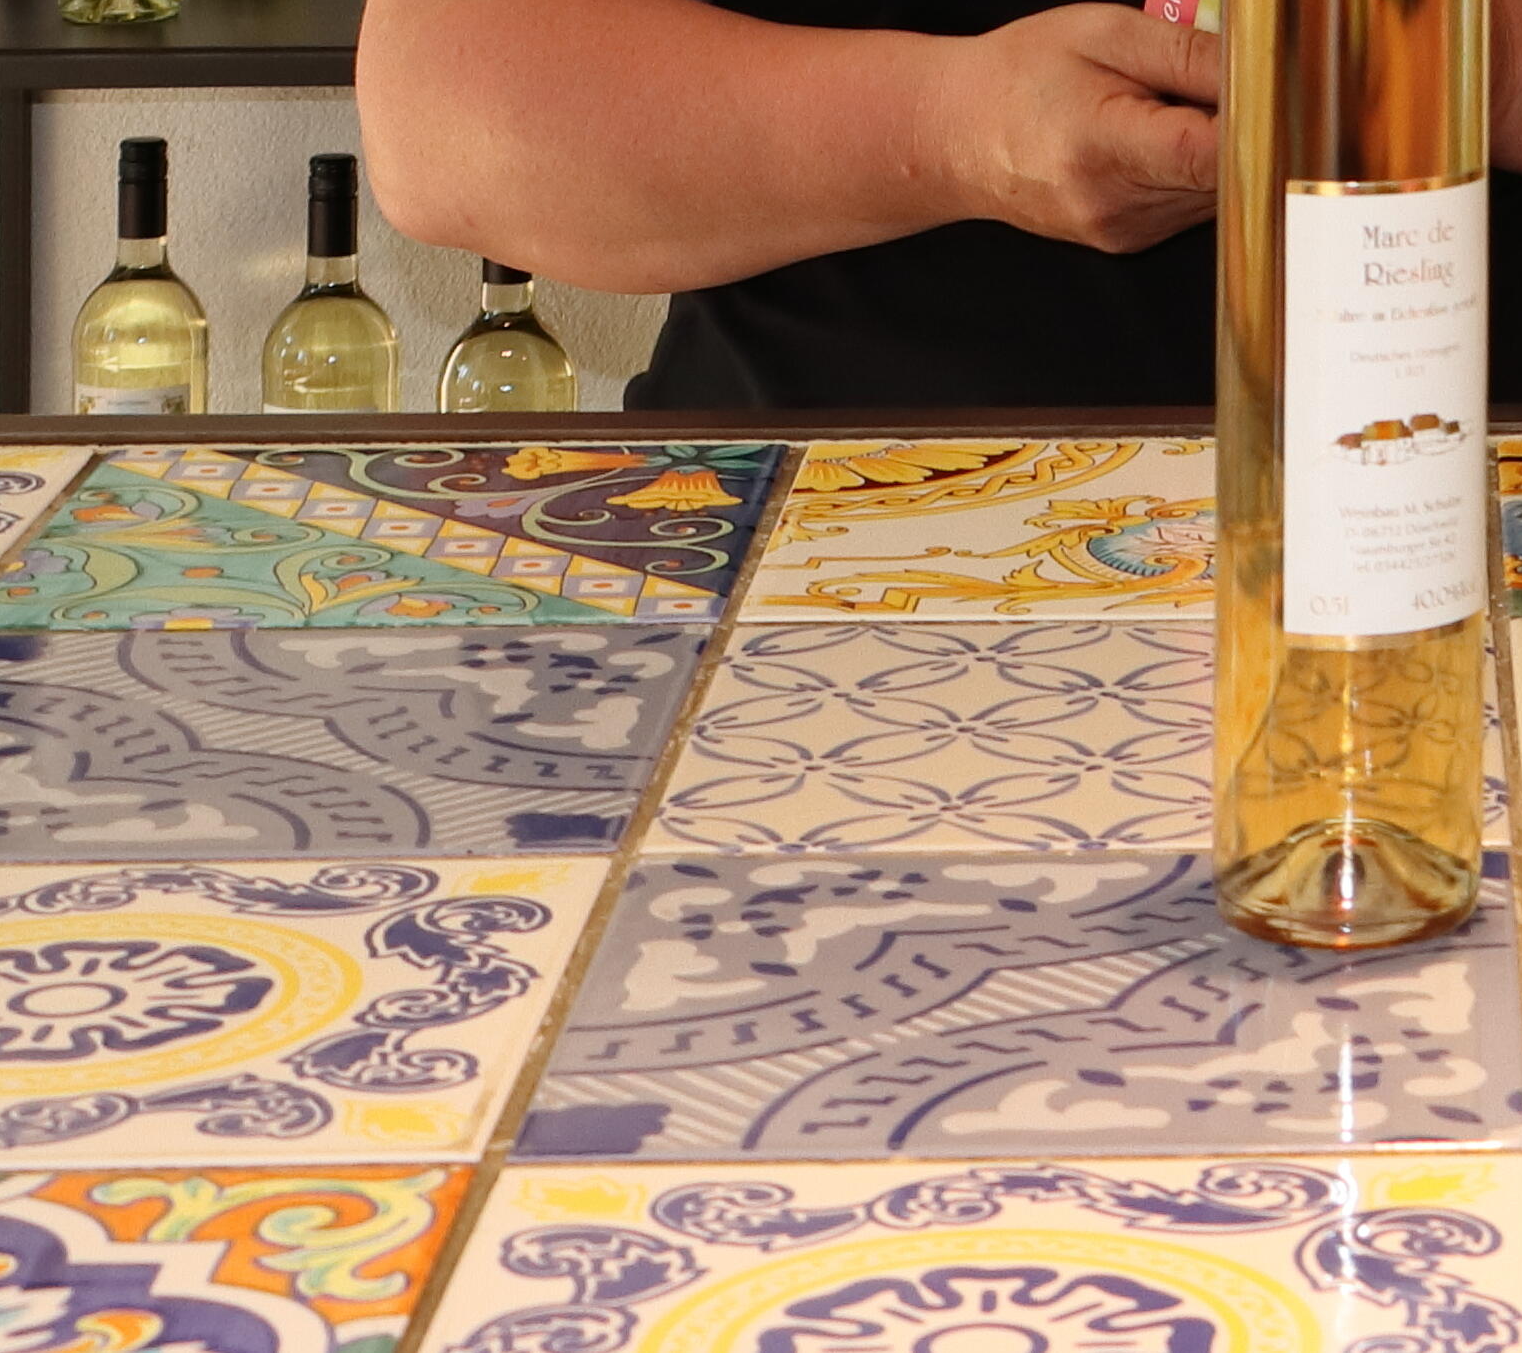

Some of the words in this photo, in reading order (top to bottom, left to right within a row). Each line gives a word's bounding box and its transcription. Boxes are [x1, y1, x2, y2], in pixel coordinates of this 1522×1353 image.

[1362, 225, 1419, 250] Marc
[1427, 218, 1455, 243] de
[1362, 257, 1456, 289] Riesling
